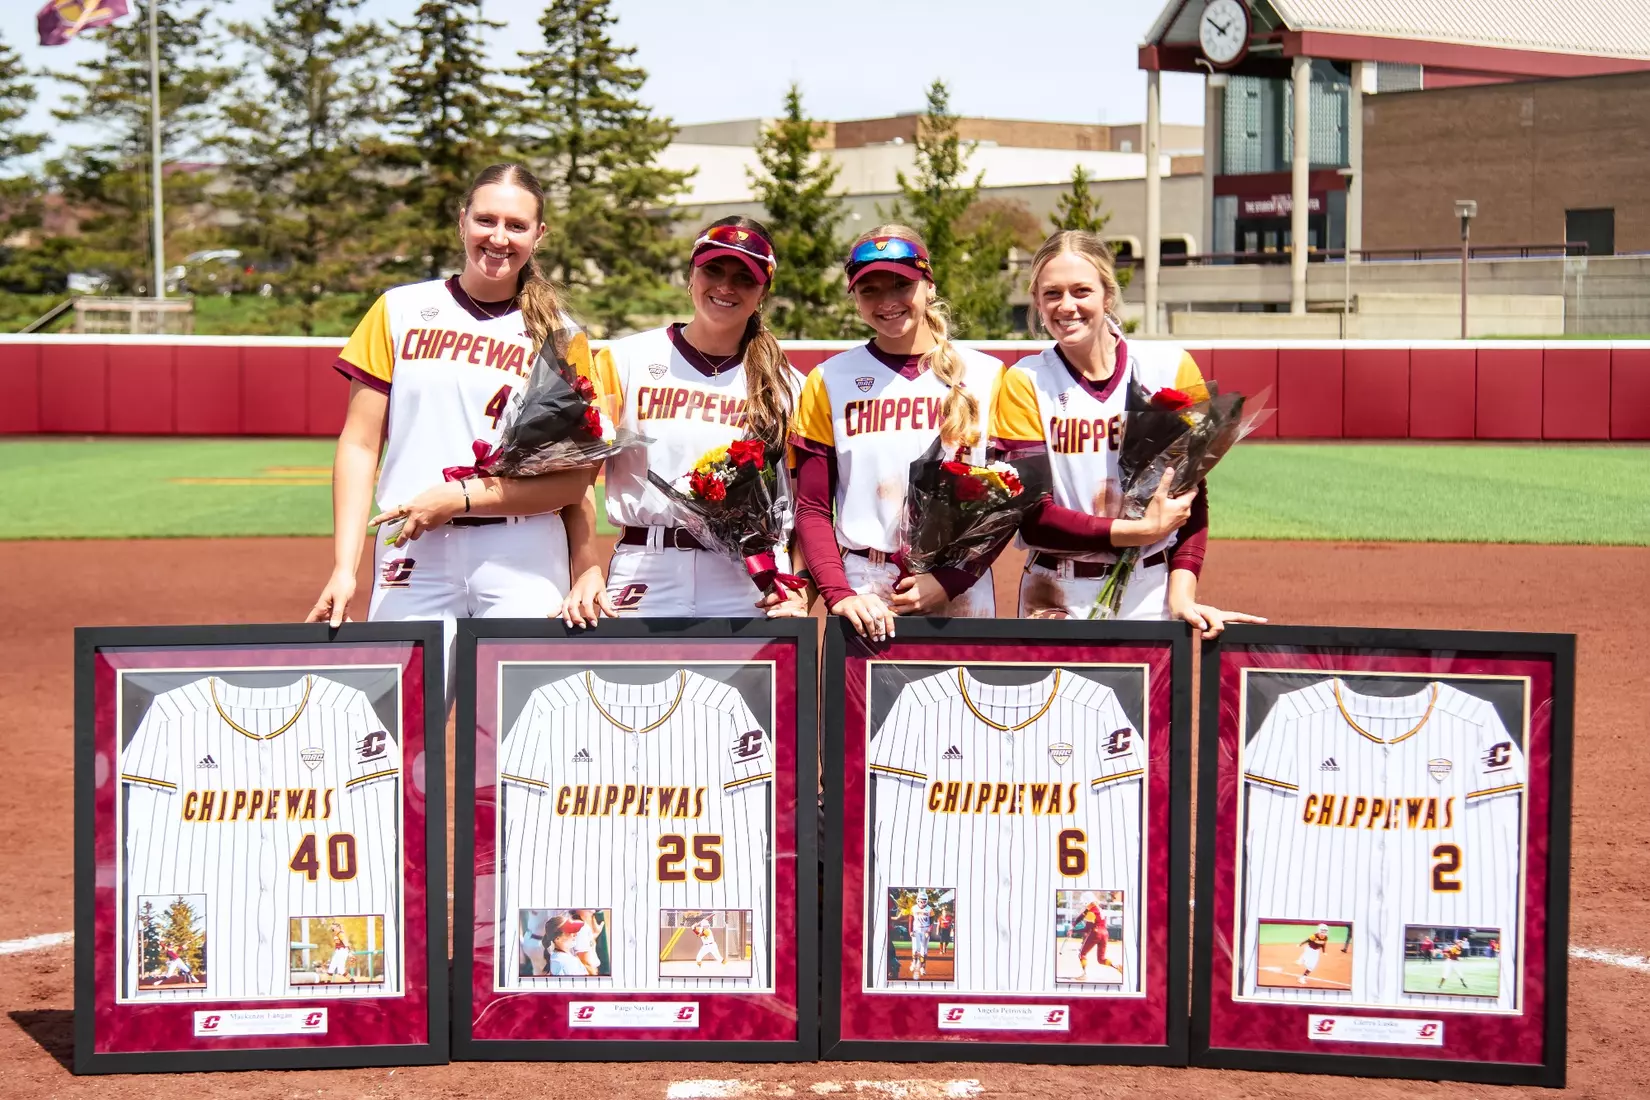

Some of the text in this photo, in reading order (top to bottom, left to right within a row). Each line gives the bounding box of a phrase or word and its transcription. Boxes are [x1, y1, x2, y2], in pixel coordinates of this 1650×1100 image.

[484, 384, 513, 430] 4
[637, 386, 748, 429] CHIPPEW
[844, 396, 946, 437] CHIPPEW
[1049, 414, 1121, 453] CHIPPE
[182, 787, 336, 821] CHIPPEWAS
[556, 784, 708, 818] CHIPPEWAS
[928, 780, 1081, 816] CHIPPEWAS
[1303, 793, 1456, 829] CHIPPEWAS
[288, 832, 358, 882] 40
[656, 833, 724, 883] 25
[1057, 827, 1088, 878] 6
[1431, 842, 1463, 893] 2
